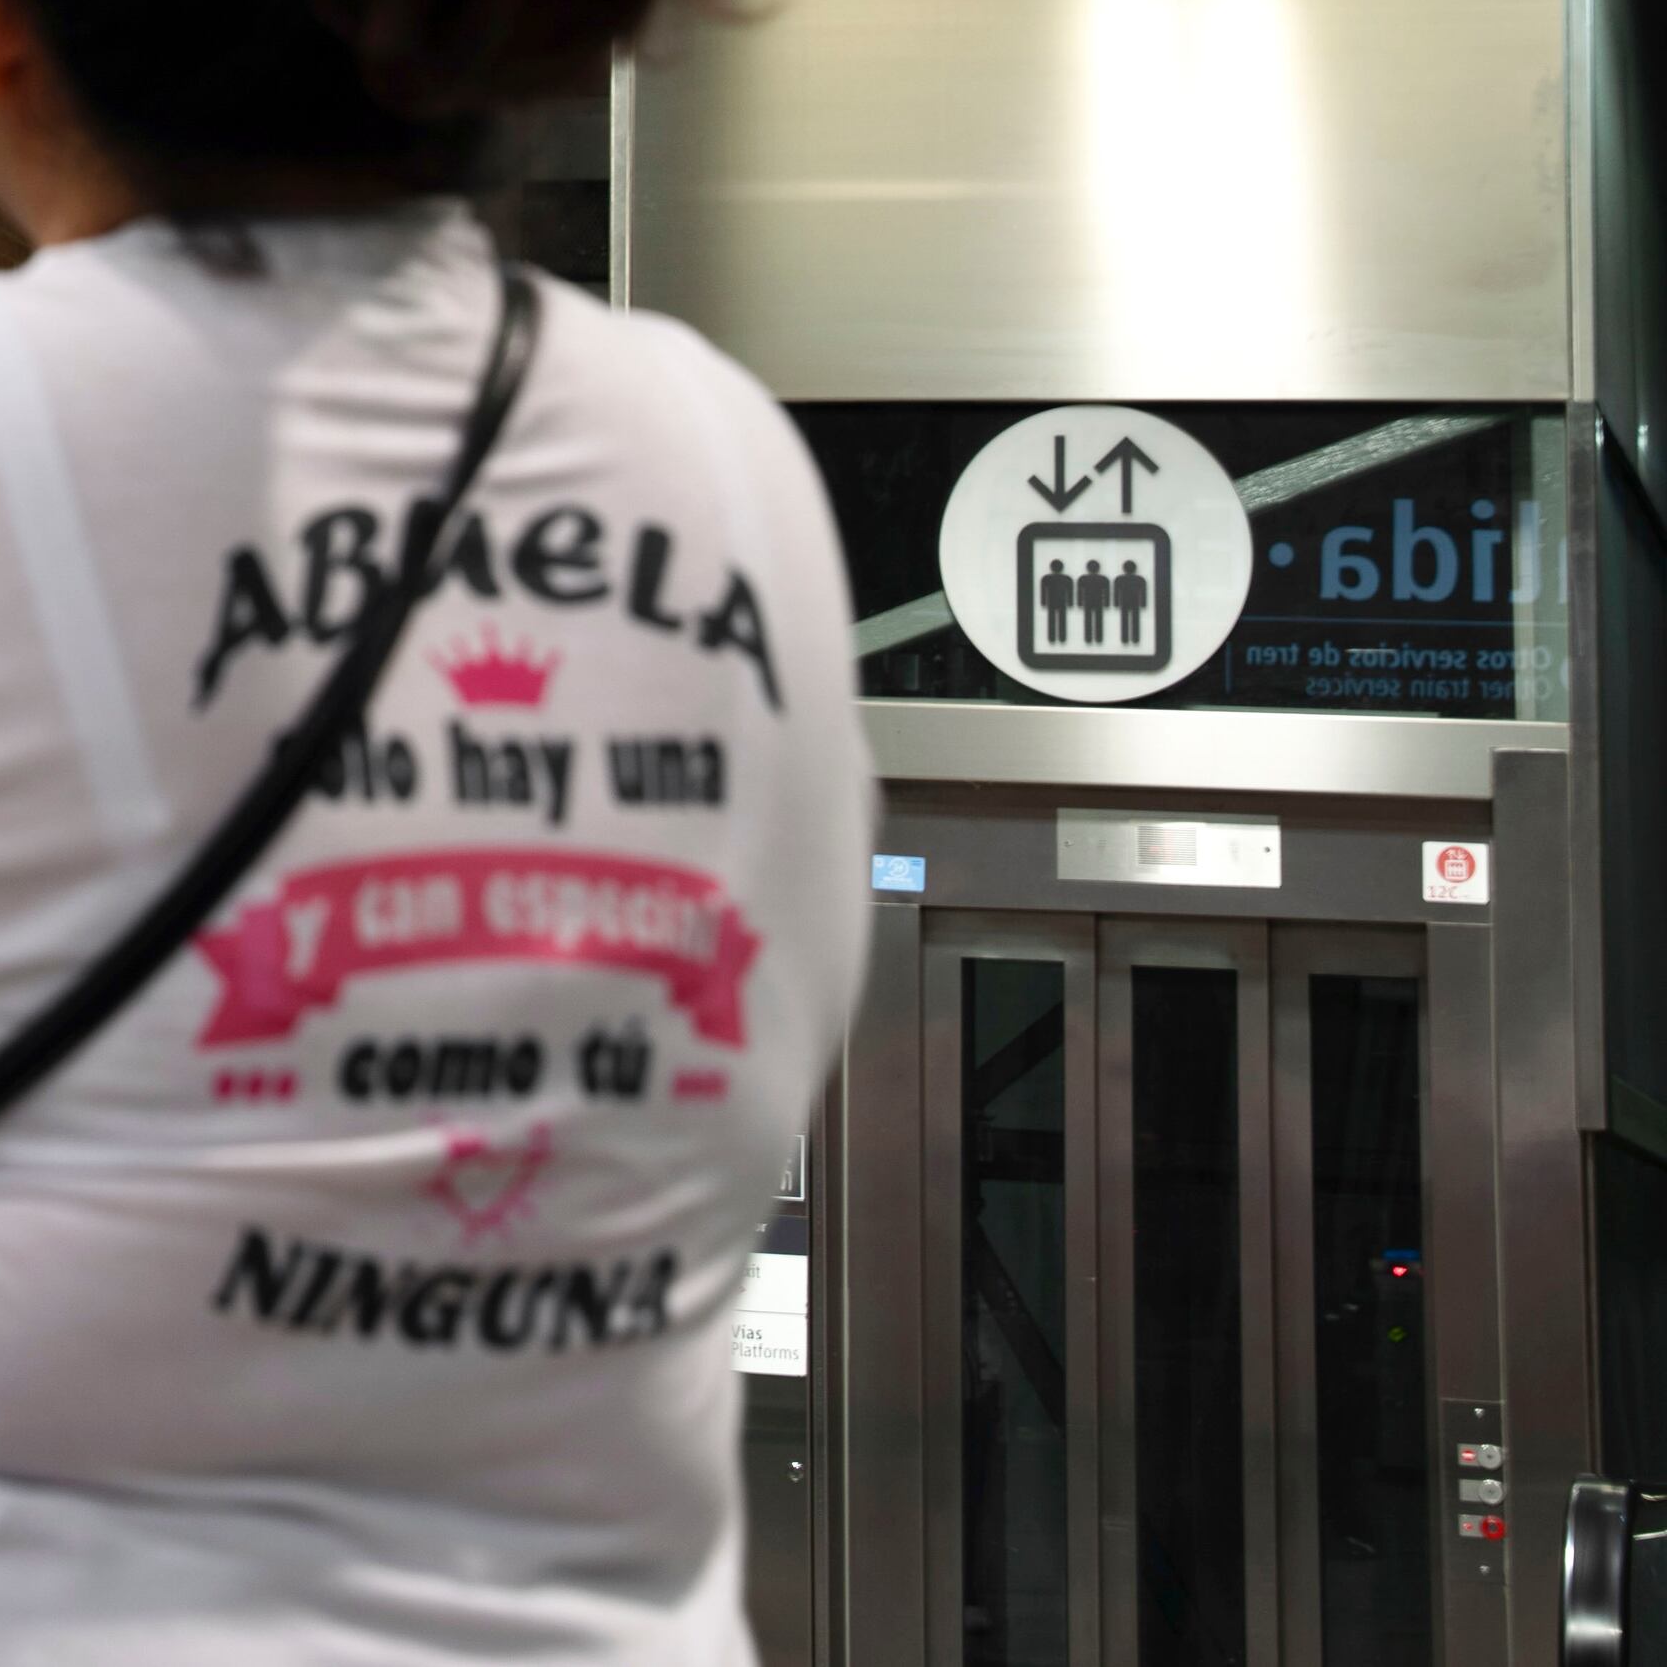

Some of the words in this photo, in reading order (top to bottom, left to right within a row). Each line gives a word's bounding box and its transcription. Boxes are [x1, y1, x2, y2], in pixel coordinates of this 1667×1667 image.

[450, 720, 571, 825] hay
[608, 737, 725, 805] una
[339, 1033, 543, 1102] como
[214, 1223, 678, 1352] NINGUNA
